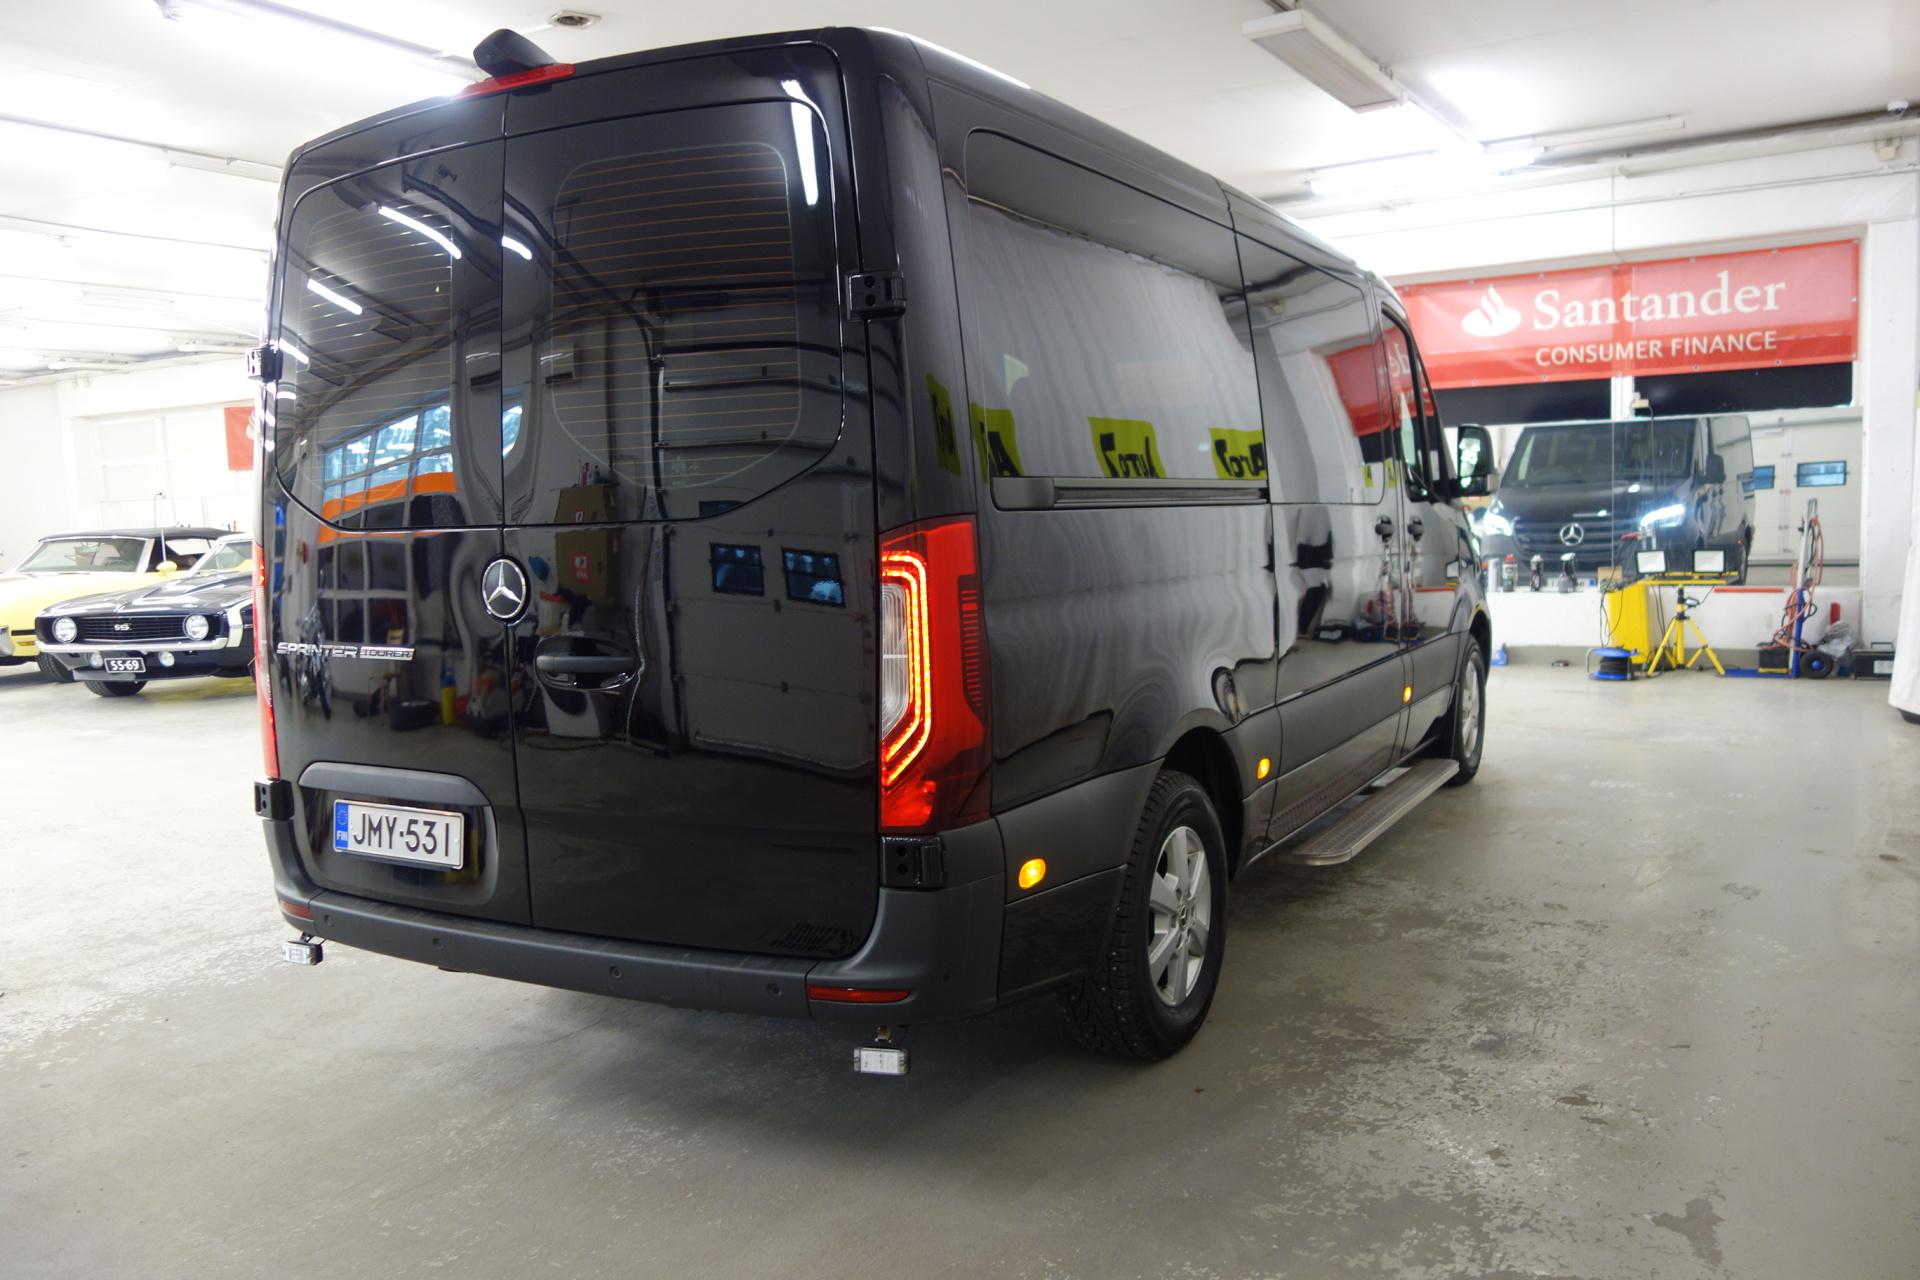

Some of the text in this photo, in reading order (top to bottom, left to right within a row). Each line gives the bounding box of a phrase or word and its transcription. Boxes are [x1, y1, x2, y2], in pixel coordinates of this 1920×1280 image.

[1533, 270, 1786, 331] Santander
[1535, 331, 1778, 366] CONSUMER FINANCE
[114, 623, 131, 631] SS
[276, 642, 412, 659] SPRINTER TOURER
[110, 660, 139, 671] SS-69
[353, 813, 450, 857] JMY-531
